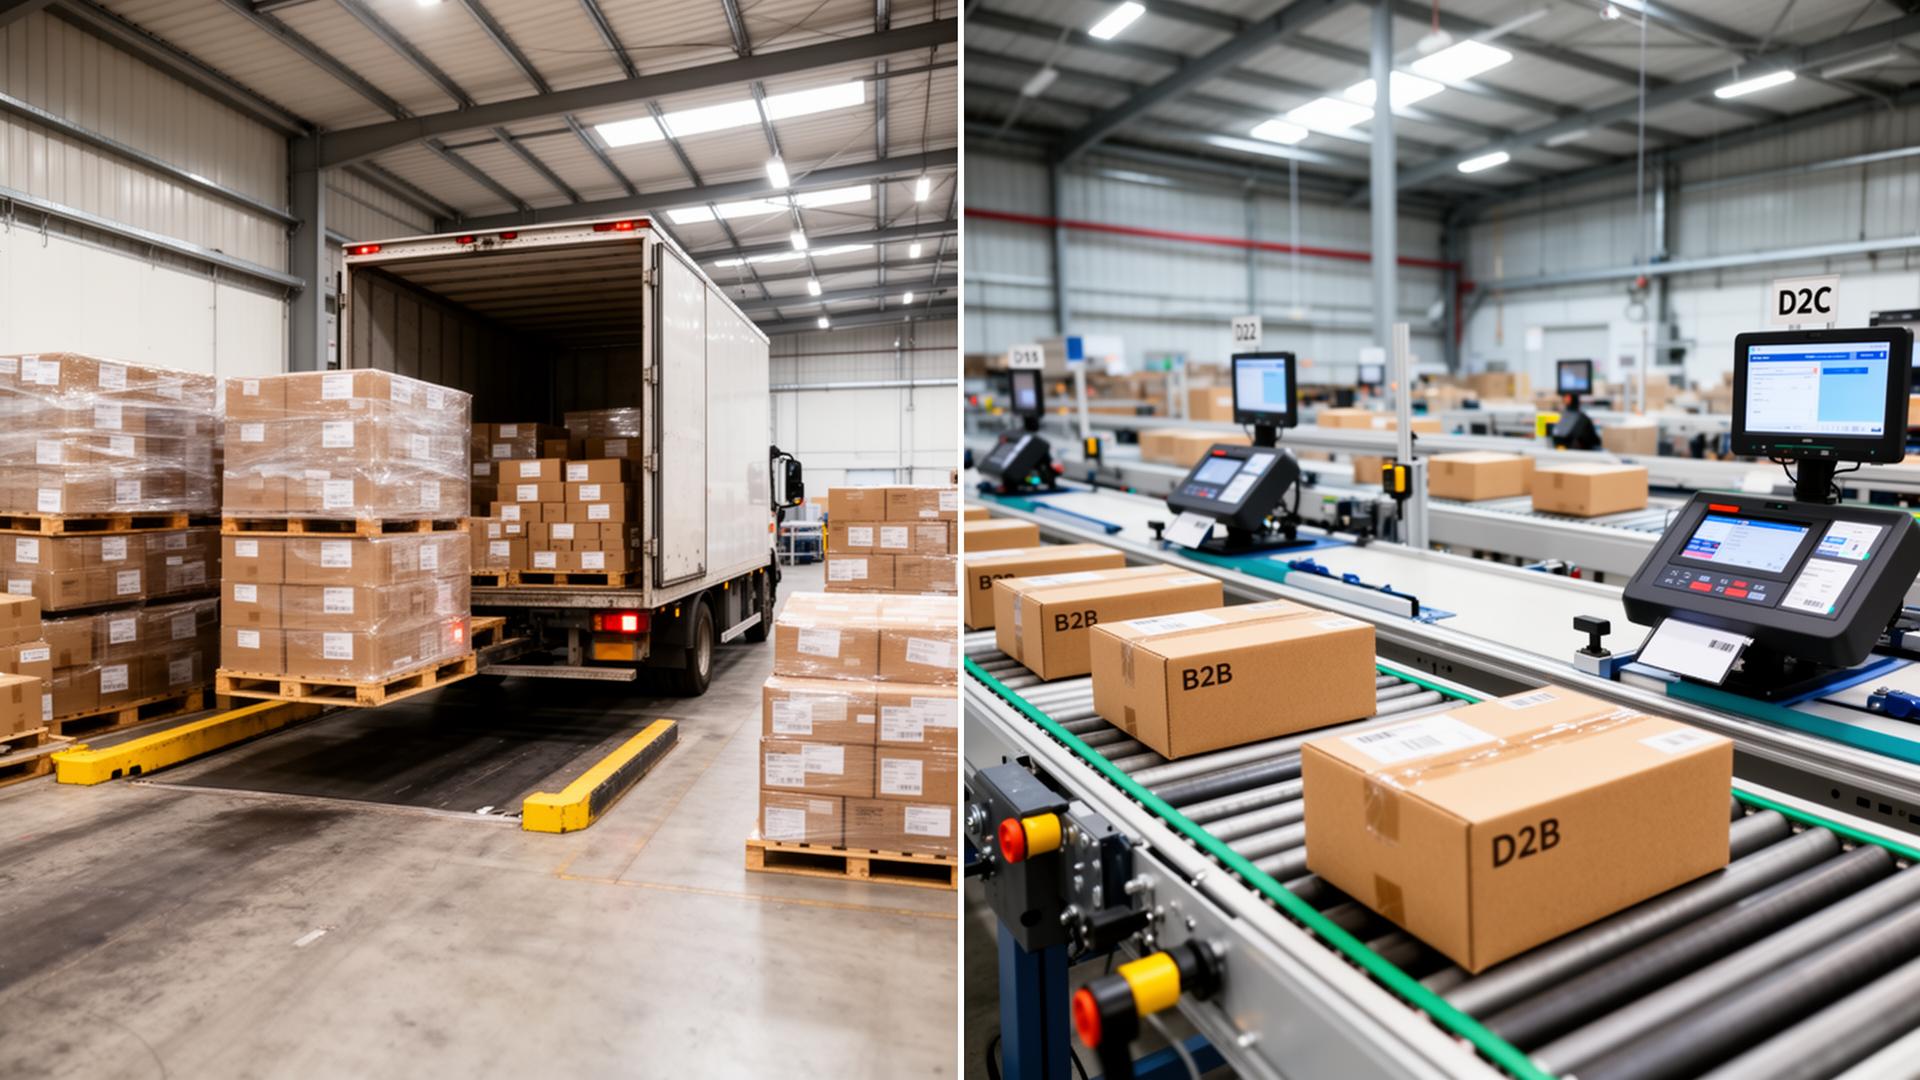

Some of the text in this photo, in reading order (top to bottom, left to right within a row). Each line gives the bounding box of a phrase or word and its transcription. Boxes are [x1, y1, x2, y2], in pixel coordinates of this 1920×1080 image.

[1778, 285, 1832, 316] D2C
[1054, 609, 1099, 633] B2B
[1182, 662, 1233, 691] B2B
[1492, 818, 1561, 869] D2B
